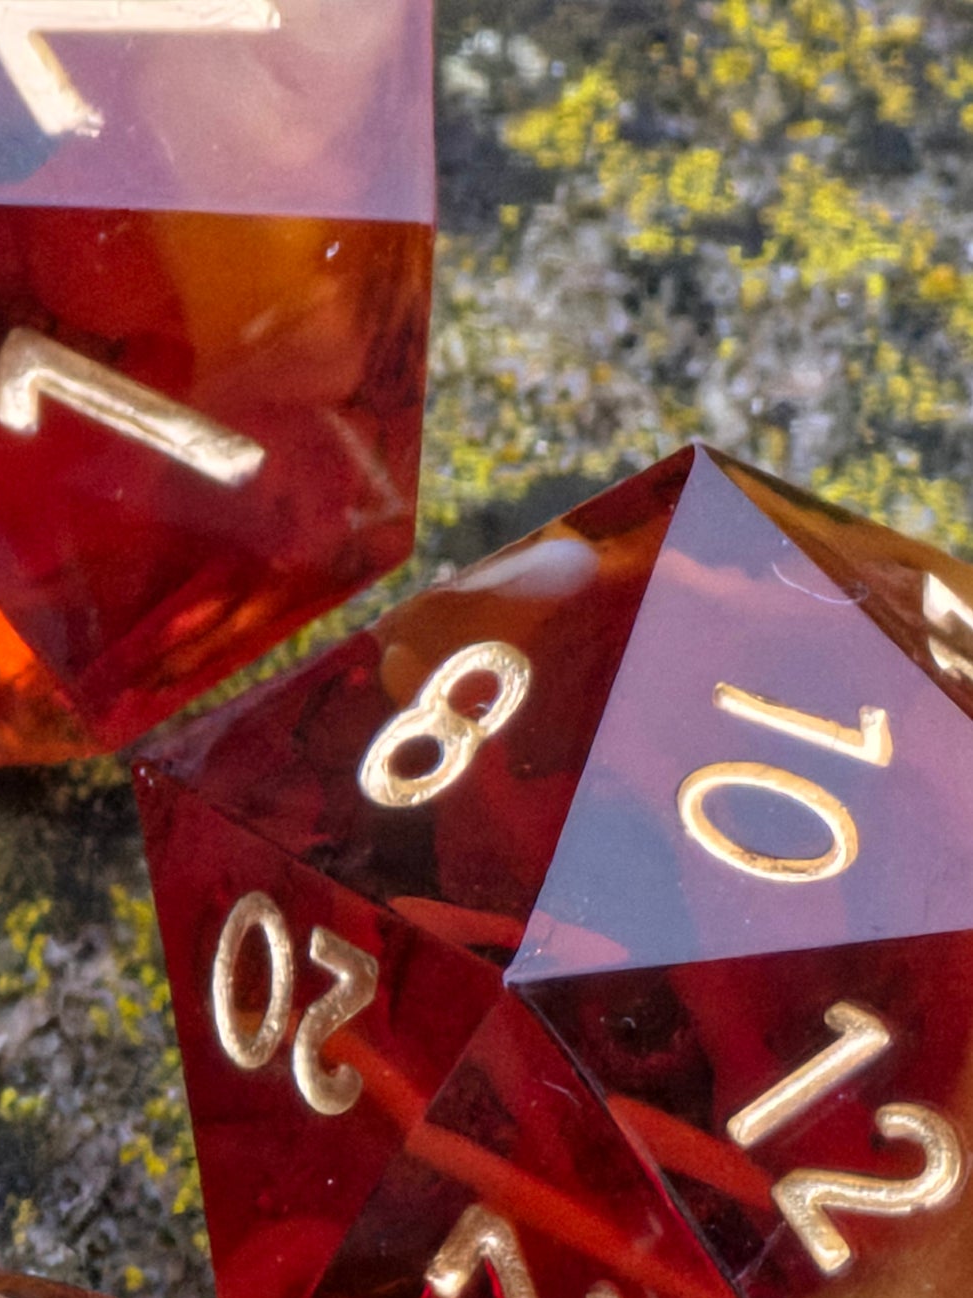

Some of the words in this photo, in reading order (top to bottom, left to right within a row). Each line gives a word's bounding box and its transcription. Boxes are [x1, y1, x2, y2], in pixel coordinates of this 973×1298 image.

[358, 641, 532, 808] 8
[677, 681, 893, 883] 10
[213, 891, 379, 1116] 20
[726, 1001, 963, 1274] 12
